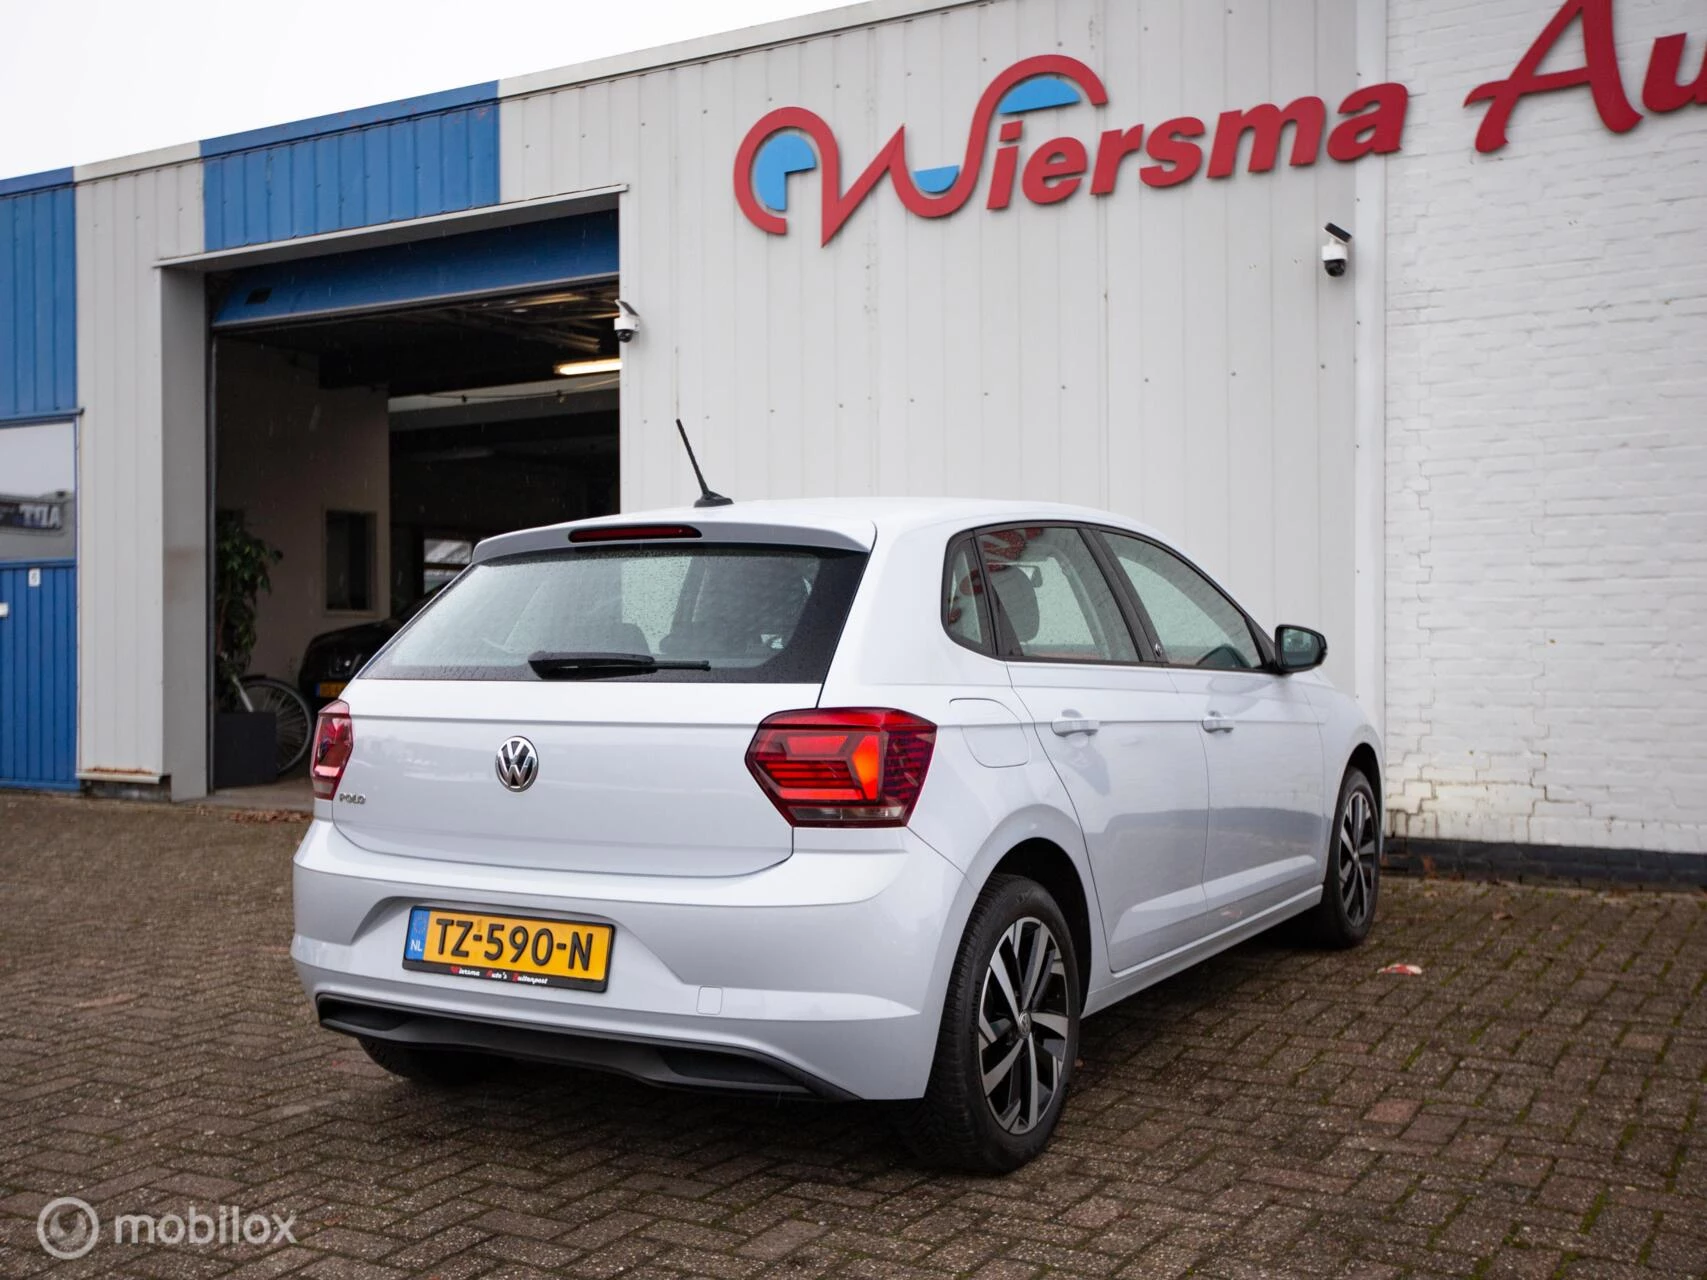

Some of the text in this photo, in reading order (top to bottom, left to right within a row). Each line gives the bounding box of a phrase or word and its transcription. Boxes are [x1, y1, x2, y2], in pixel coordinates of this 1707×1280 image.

[734, 53, 1409, 247] Wiersma
[339, 792, 366, 805] POLO
[410, 941, 423, 952] NL
[436, 918, 593, 971] TZ-590-N
